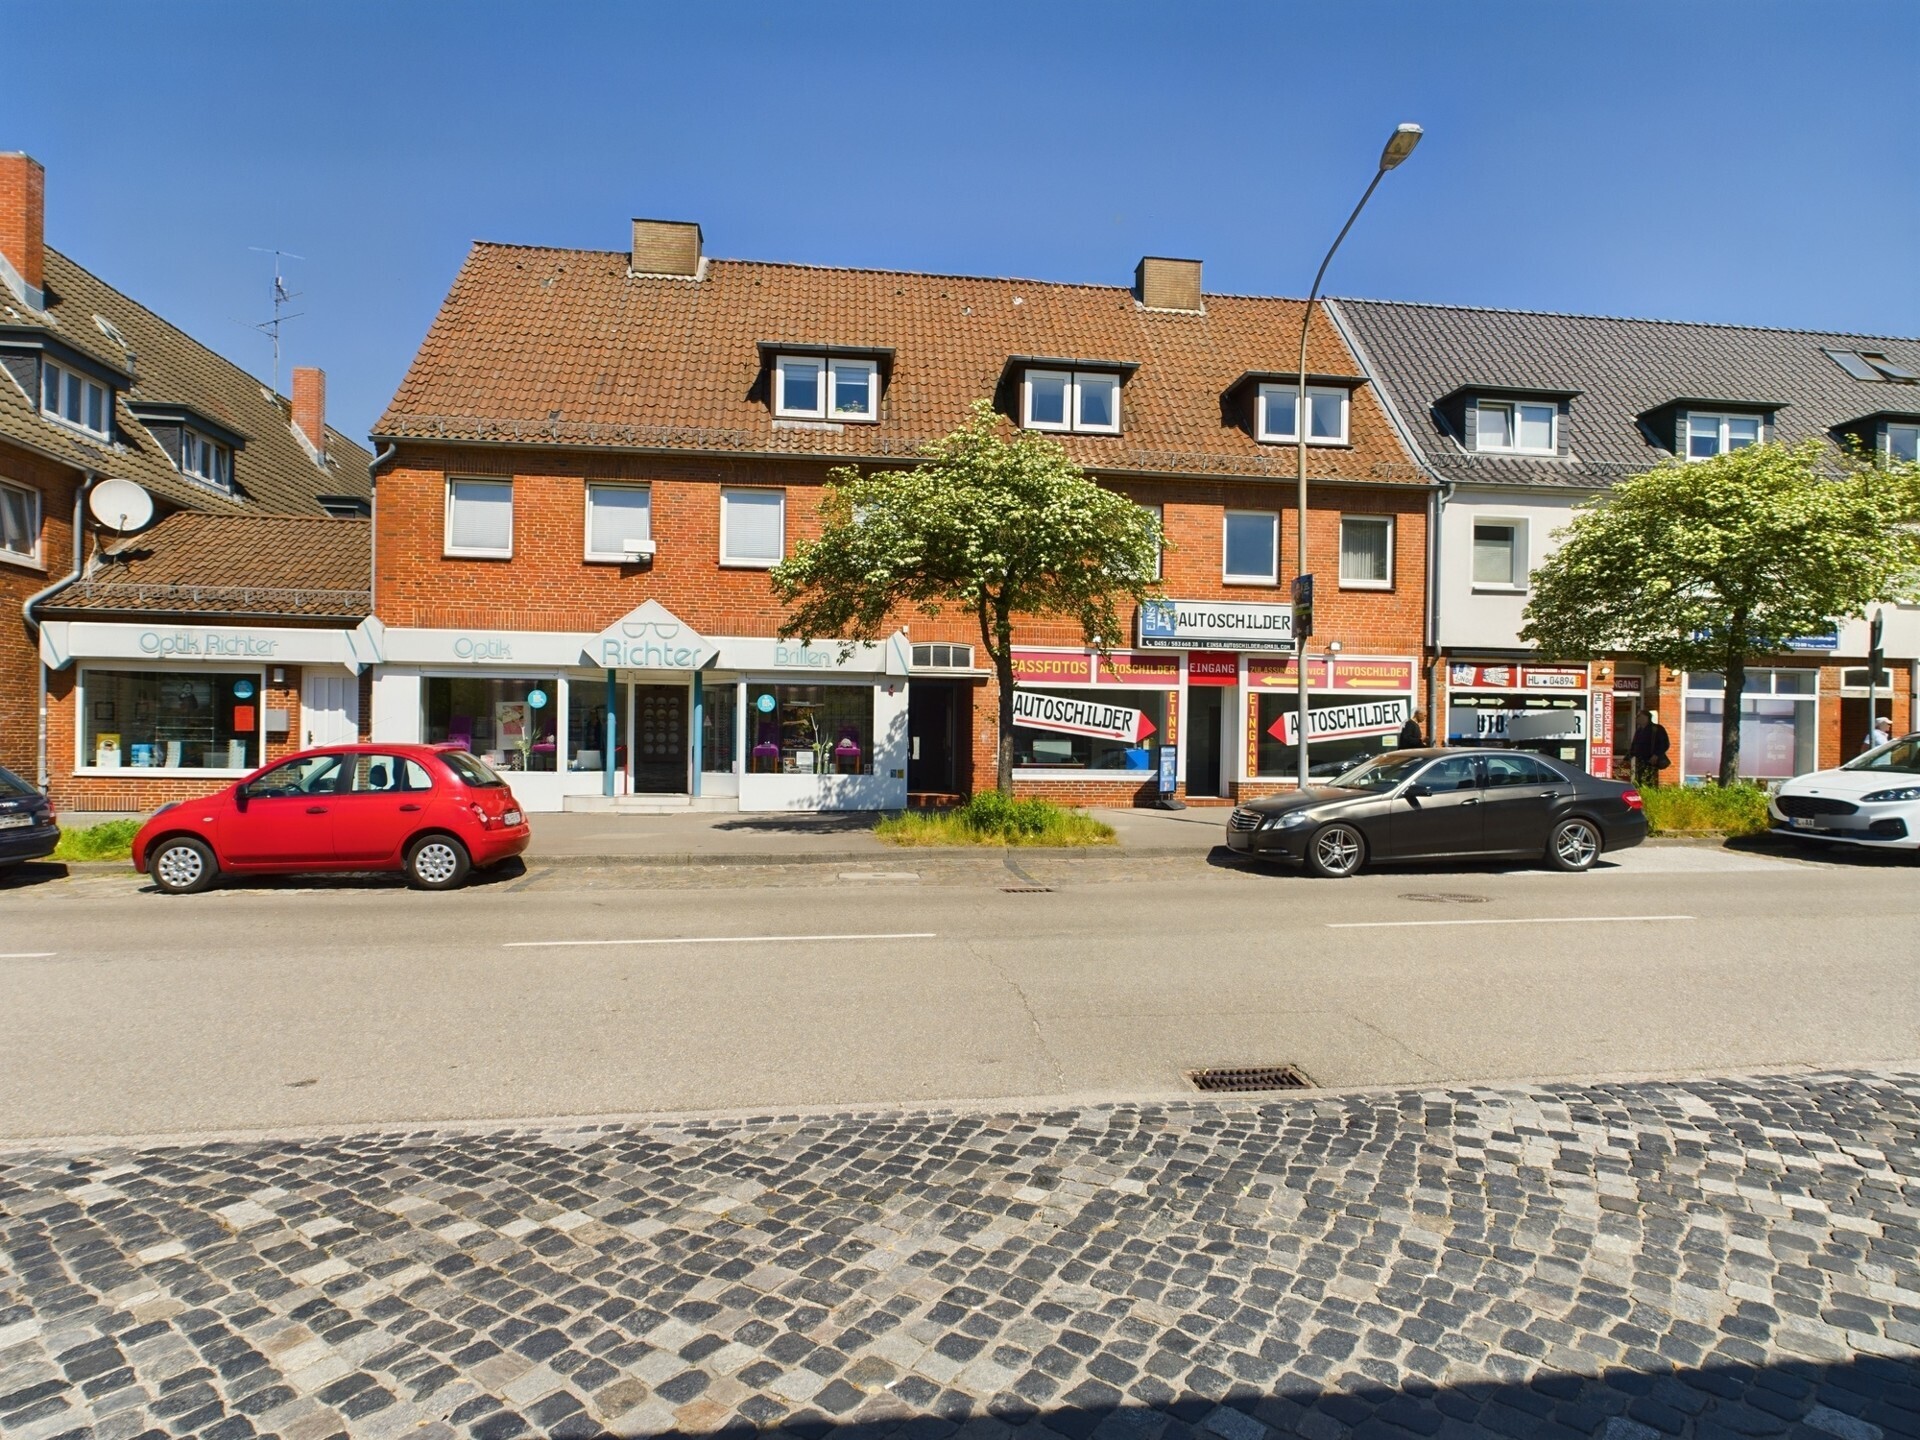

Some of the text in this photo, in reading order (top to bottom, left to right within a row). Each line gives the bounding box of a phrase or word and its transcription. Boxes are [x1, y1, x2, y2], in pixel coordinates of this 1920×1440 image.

[1178, 612, 1291, 630] AUTOSCHILDER
[140, 632, 279, 658] Optik Richter
[454, 638, 512, 662] Optik
[602, 638, 702, 667] Richter
[775, 646, 831, 666] Brillen
[1100, 663, 1177, 676] AUTOSCHILDER
[1189, 662, 1235, 674] EINGANG
[1250, 665, 1326, 676] ZULASSUNGSSVICE
[1336, 666, 1409, 677] AUTOSCHILDER
[1013, 694, 1133, 732] AUTOSCHILDER
[1290, 702, 1402, 736] ATOSCHILDER
[1249, 693, 1257, 777] EINGANG
[1591, 746, 1611, 755] HIER
